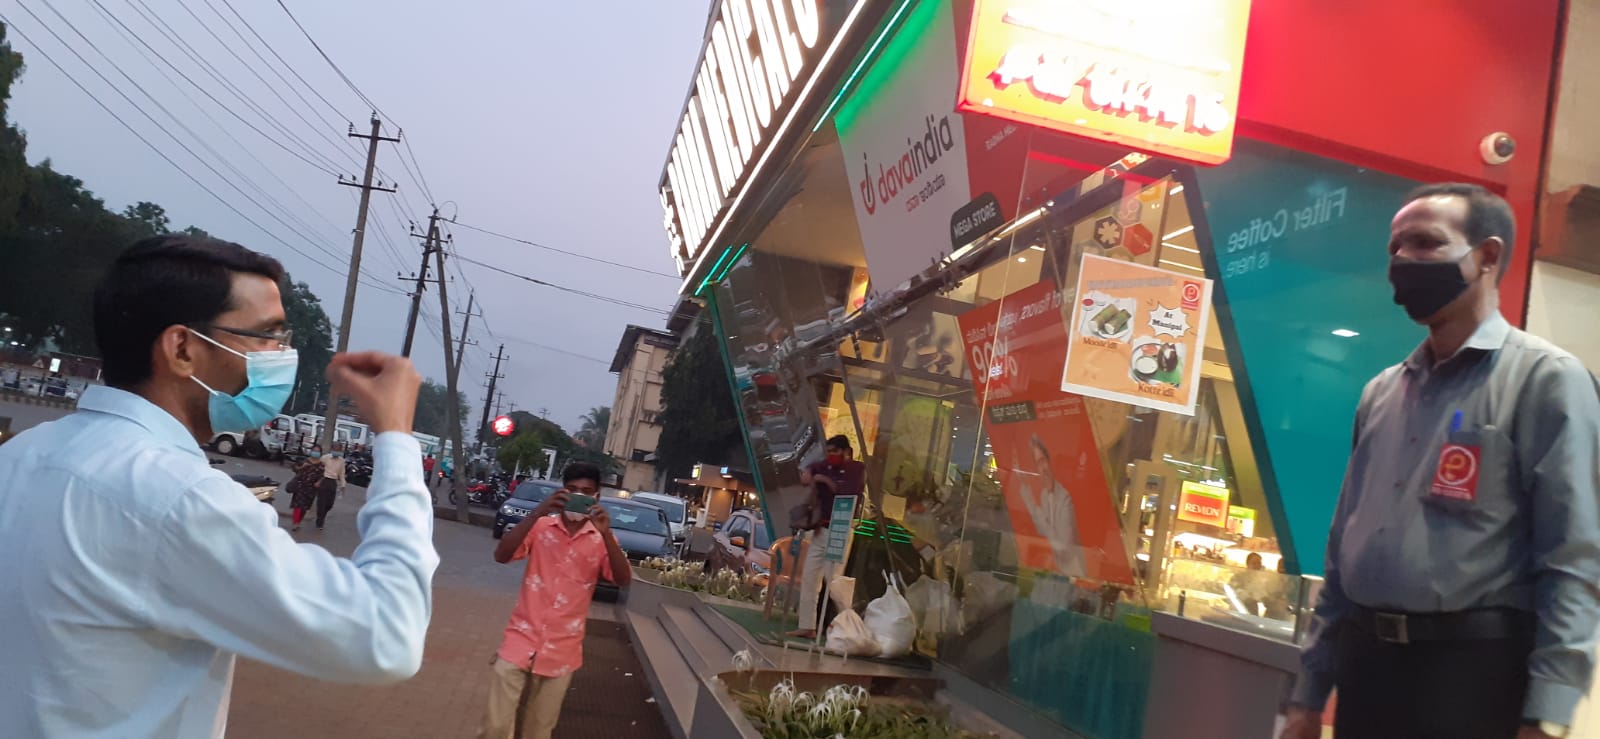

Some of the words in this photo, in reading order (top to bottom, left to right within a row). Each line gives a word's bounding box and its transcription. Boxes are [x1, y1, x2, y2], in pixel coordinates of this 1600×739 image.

[878, 113, 954, 205] davaindia
[953, 216, 973, 239] MEGA
[972, 201, 997, 227] STORE
[1152, 318, 1183, 332] Manipal
[1184, 503, 1220, 517] REVLON
